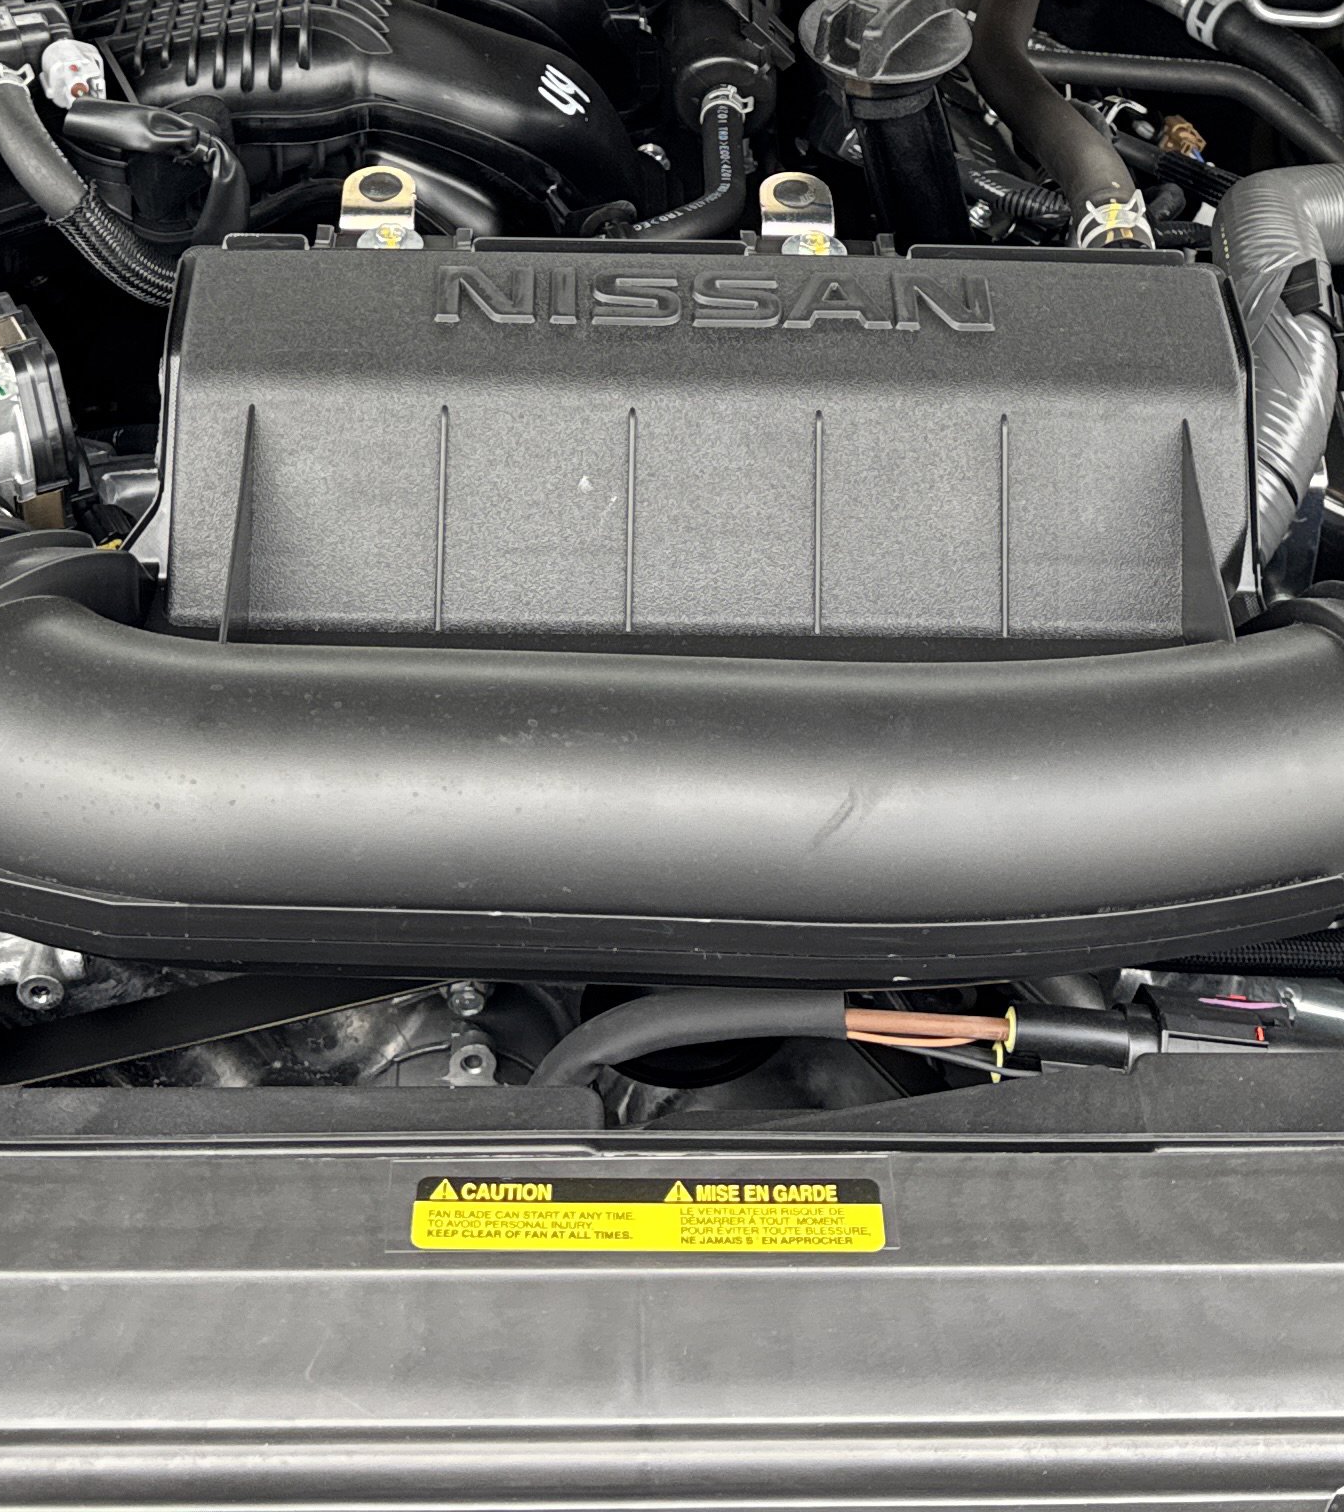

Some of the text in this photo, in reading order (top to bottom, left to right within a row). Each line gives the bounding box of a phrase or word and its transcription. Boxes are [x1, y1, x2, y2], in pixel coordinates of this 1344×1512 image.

[434, 264, 996, 332] NISSAN
[461, 1183, 552, 1200] CAUTION
[696, 1185, 838, 1202] MISE EN GARDE
[429, 1210, 451, 1218] FAN
[455, 1210, 491, 1219] BLADE
[496, 1211, 519, 1219] CAN
[524, 1211, 560, 1220] START
[563, 1212, 575, 1220] AT
[579, 1212, 602, 1220] ANY
[680, 1208, 844, 1216] LE VENTILATEUR RISQUE DE
[429, 1219, 443, 1227] TO
[446, 1220, 481, 1228] AVOID
[485, 1220, 548, 1229] PERSONAL
[760, 1217, 790, 1225] TOUT
[427, 1230, 458, 1238] KEEP
[462, 1230, 501, 1238] CLEAR
[525, 1231, 548, 1239] FAN
[551, 1231, 565, 1239] AT
[569, 1231, 591, 1239] ALL
[681, 1227, 713, 1235] POUR
[763, 1227, 801, 1235] TOUTE
[681, 1237, 696, 1245] NE
[700, 1237, 743, 1245] JAMAIS
[762, 1237, 777, 1245] EN
[781, 1237, 853, 1245] APPROCHER
